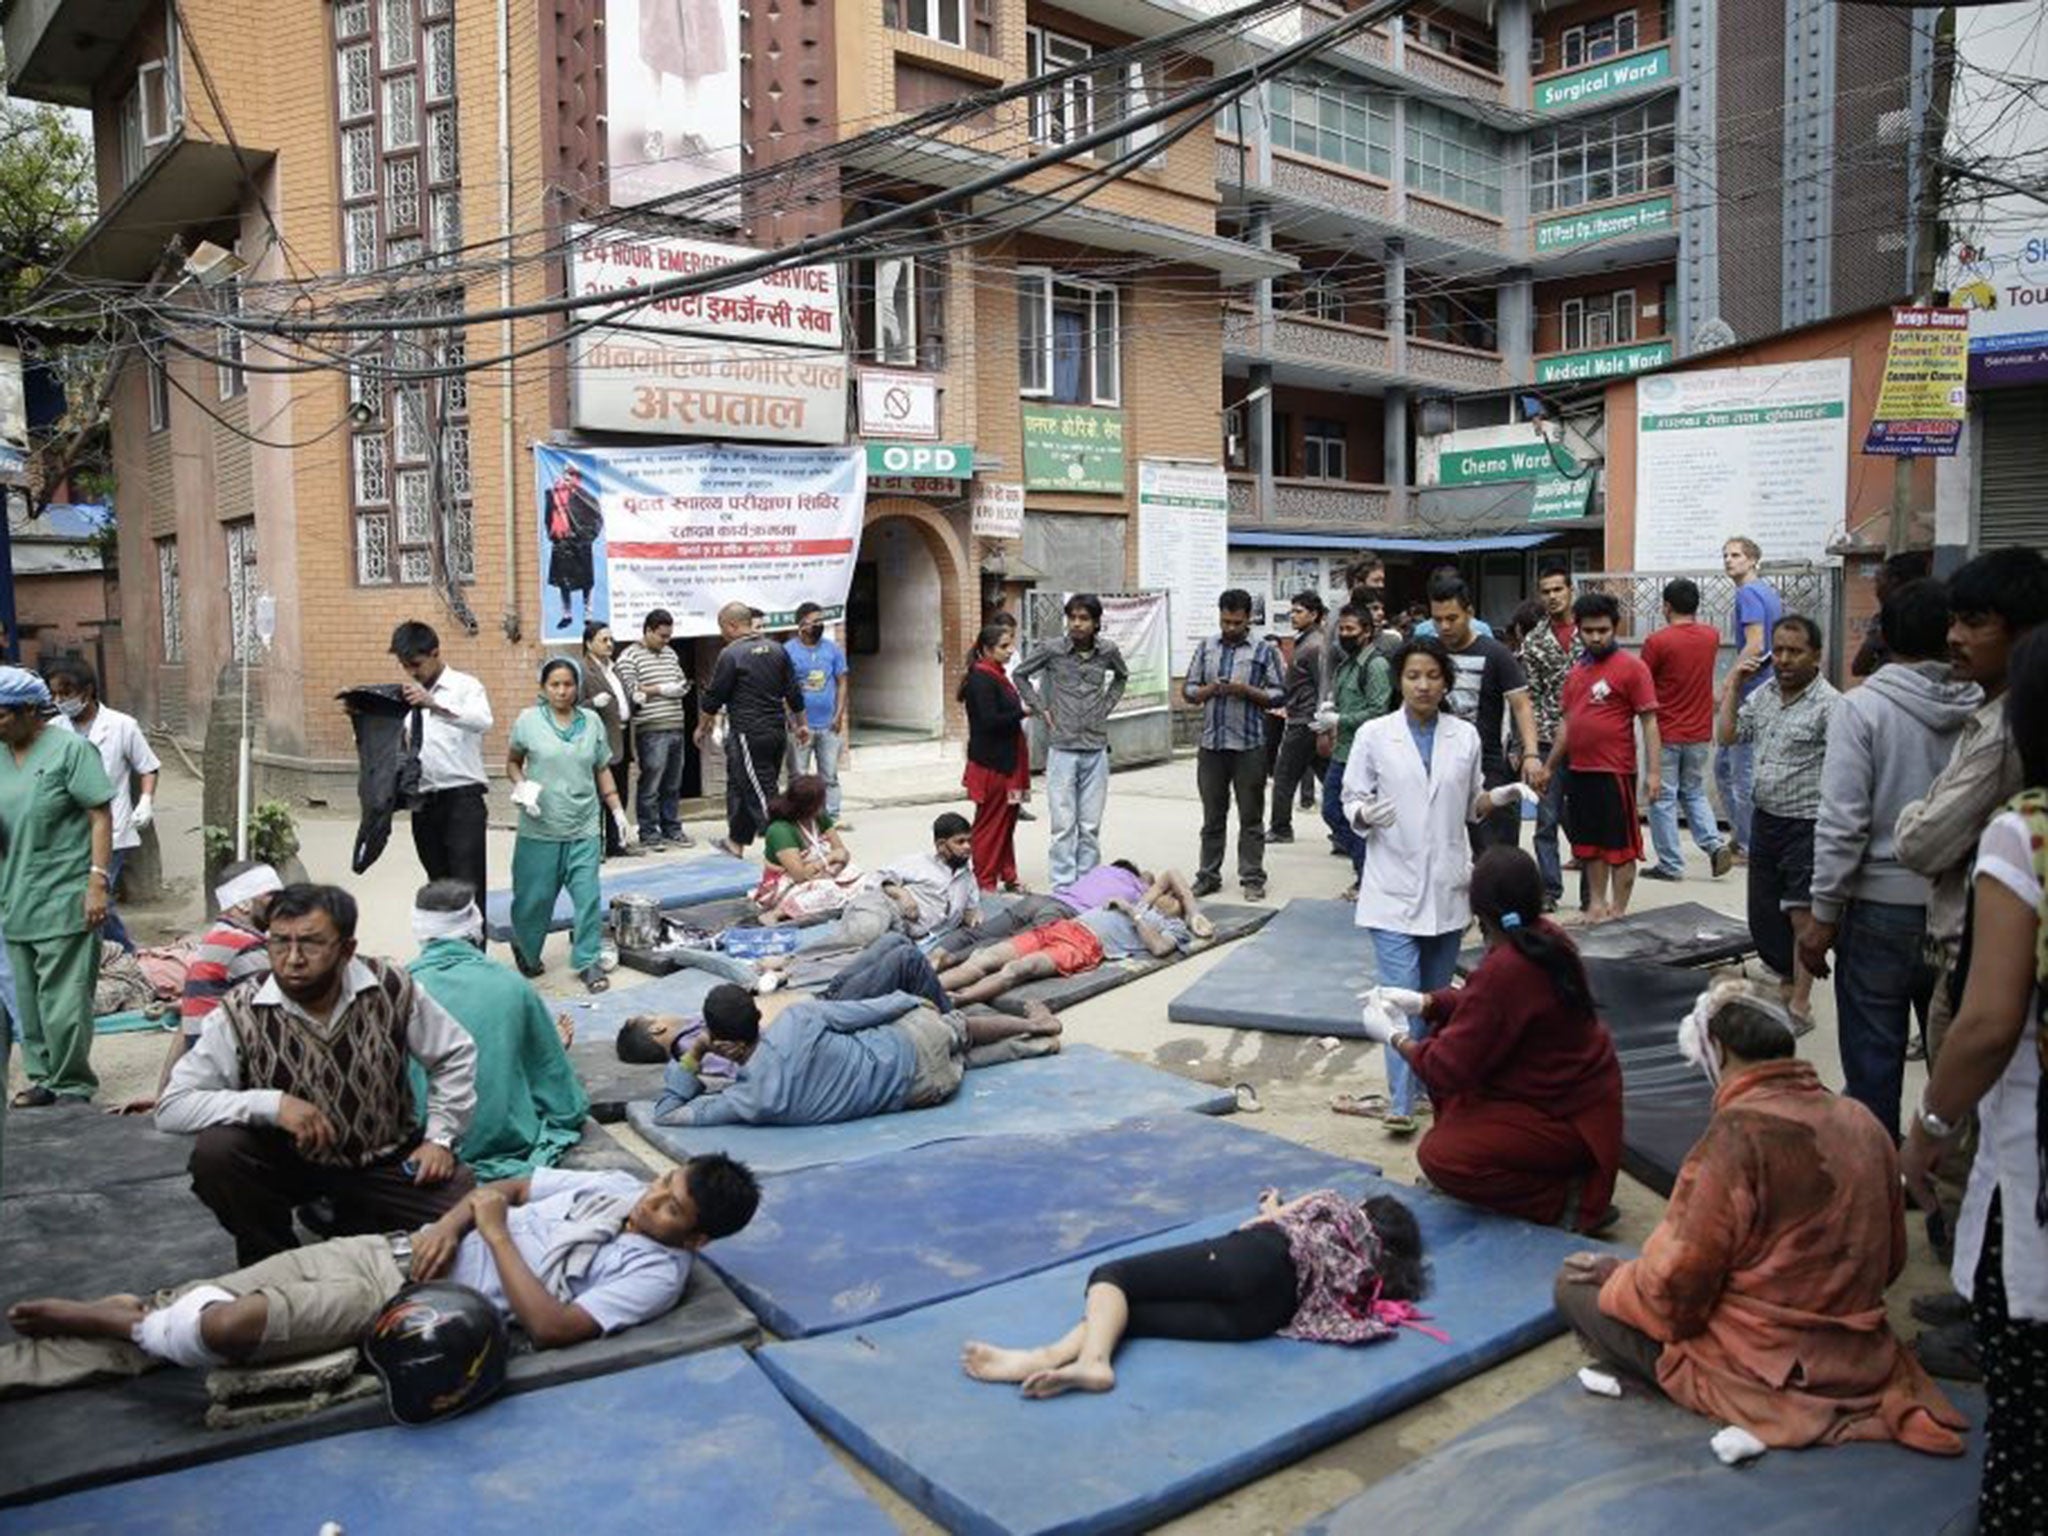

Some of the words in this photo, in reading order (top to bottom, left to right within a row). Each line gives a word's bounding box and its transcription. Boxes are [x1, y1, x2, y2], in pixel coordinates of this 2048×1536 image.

[1545, 73, 1608, 104] Surgical
[1613, 58, 1658, 84] Ward
[582, 244, 607, 264] 24
[612, 245, 653, 270] HOUR
[796, 304, 832, 333] सेवा
[1545, 360, 1590, 382] Medical
[1594, 355, 1623, 375] Male
[1628, 349, 1663, 371] Ward
[629, 384, 808, 430] अस्पताल
[883, 446, 957, 472] OPD
[1461, 457, 1507, 476] Chemo
[1511, 452, 1550, 470] Ward
